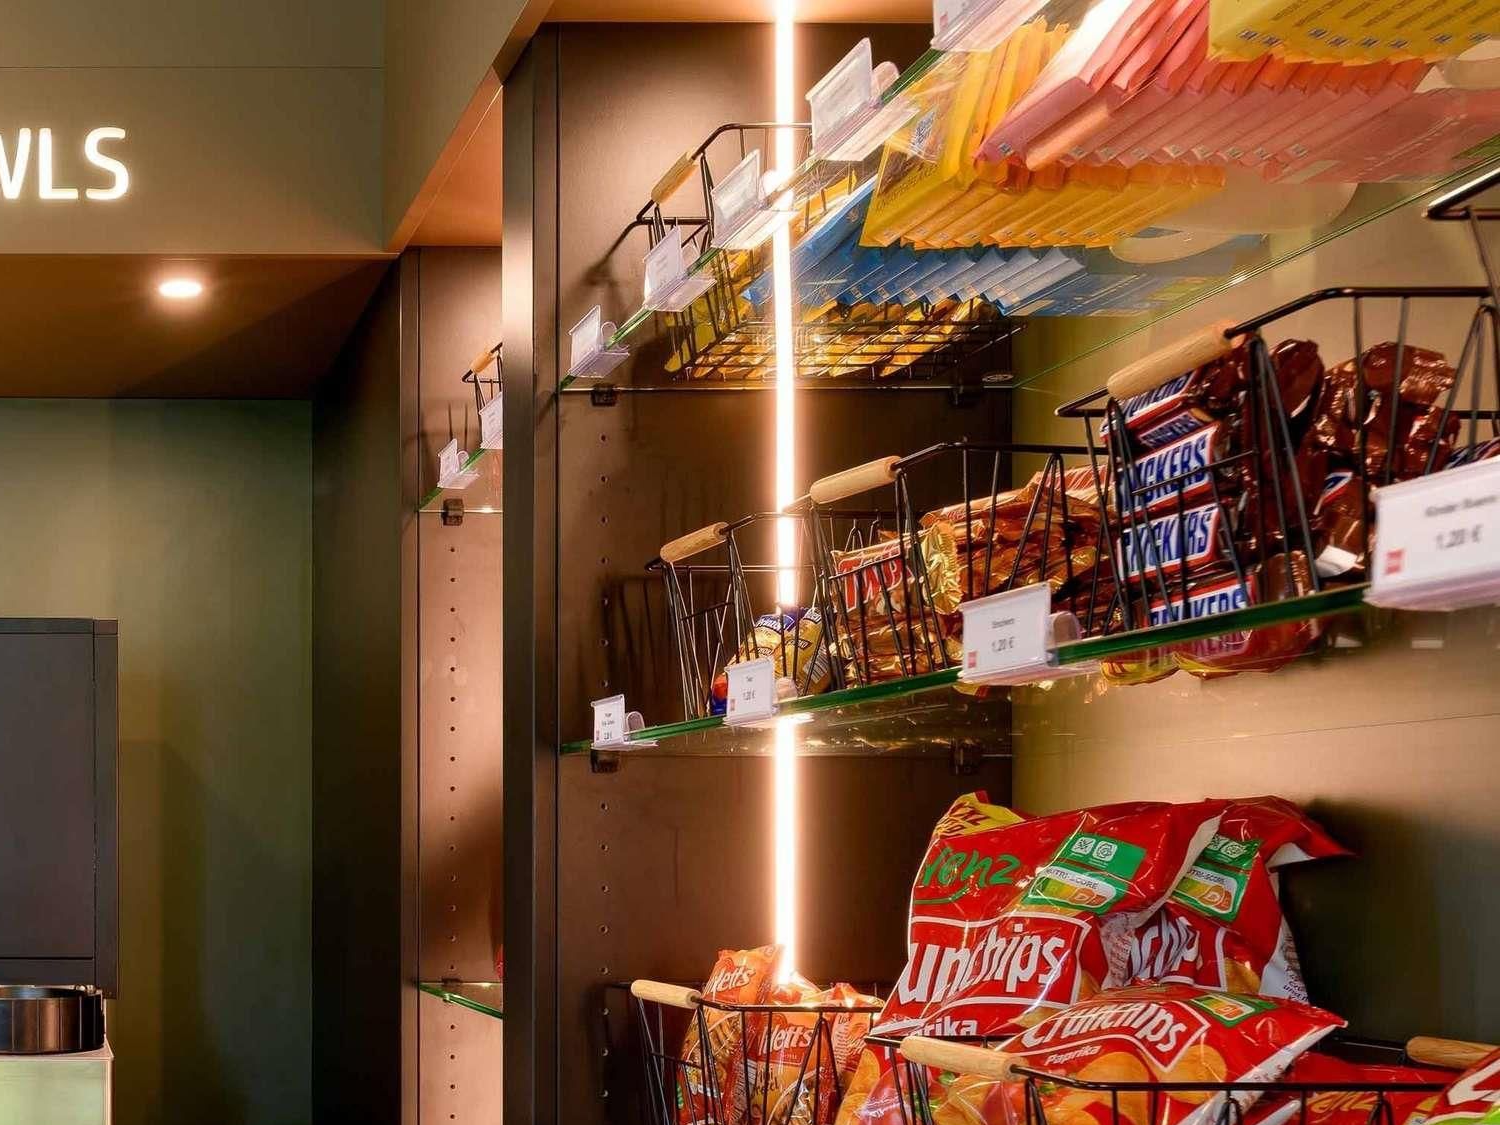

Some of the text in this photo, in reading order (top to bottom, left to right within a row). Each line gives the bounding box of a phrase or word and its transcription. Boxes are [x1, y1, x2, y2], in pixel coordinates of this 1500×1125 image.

[921, 846, 1022, 888] renz
[899, 921, 1066, 1005] unchips
[1043, 1043, 1101, 1065] Paprika
